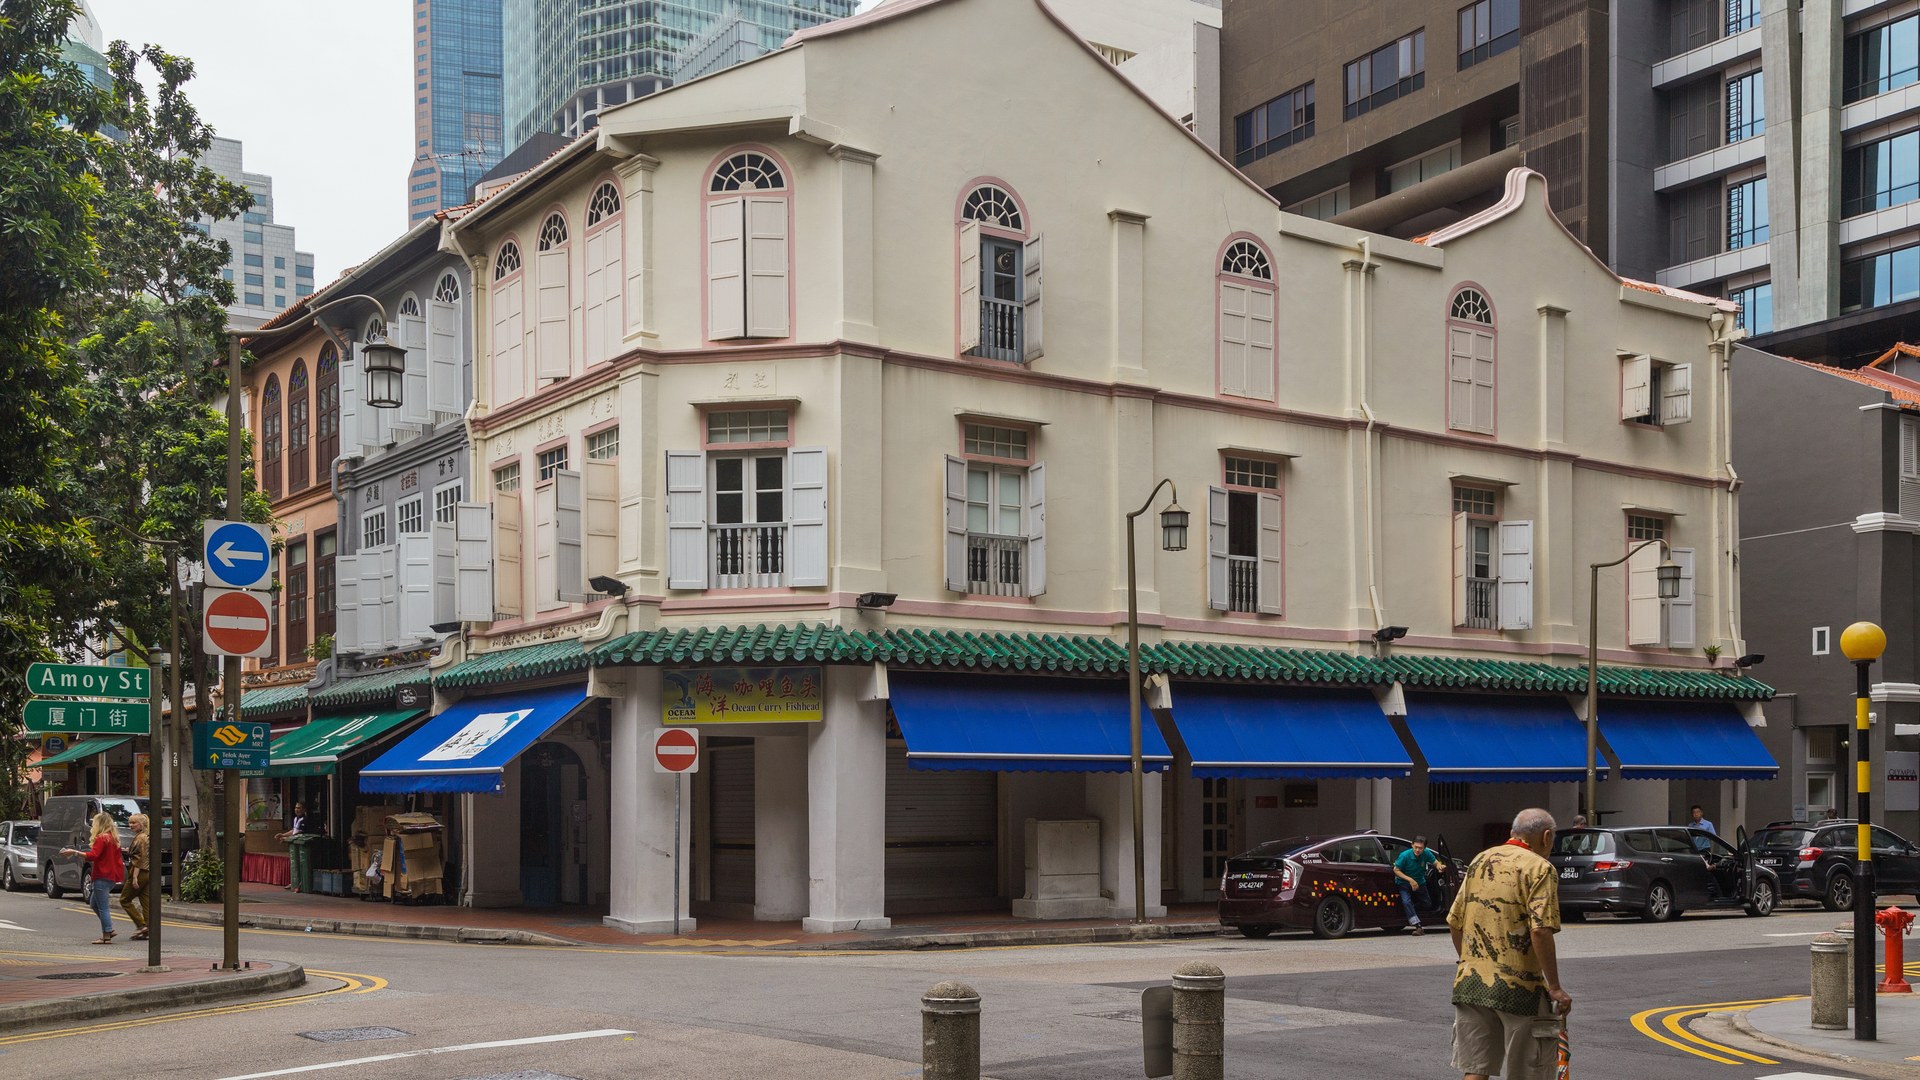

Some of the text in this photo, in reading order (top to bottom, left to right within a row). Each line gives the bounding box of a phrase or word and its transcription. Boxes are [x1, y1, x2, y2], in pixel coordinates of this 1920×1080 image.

[41, 667, 143, 693] Amoy St
[667, 709, 696, 717] OCEAN
[731, 701, 820, 714] Ocean Curry Fishhead
[48, 707, 128, 728] 厦门街
[238, 752, 251, 760] Ayer
